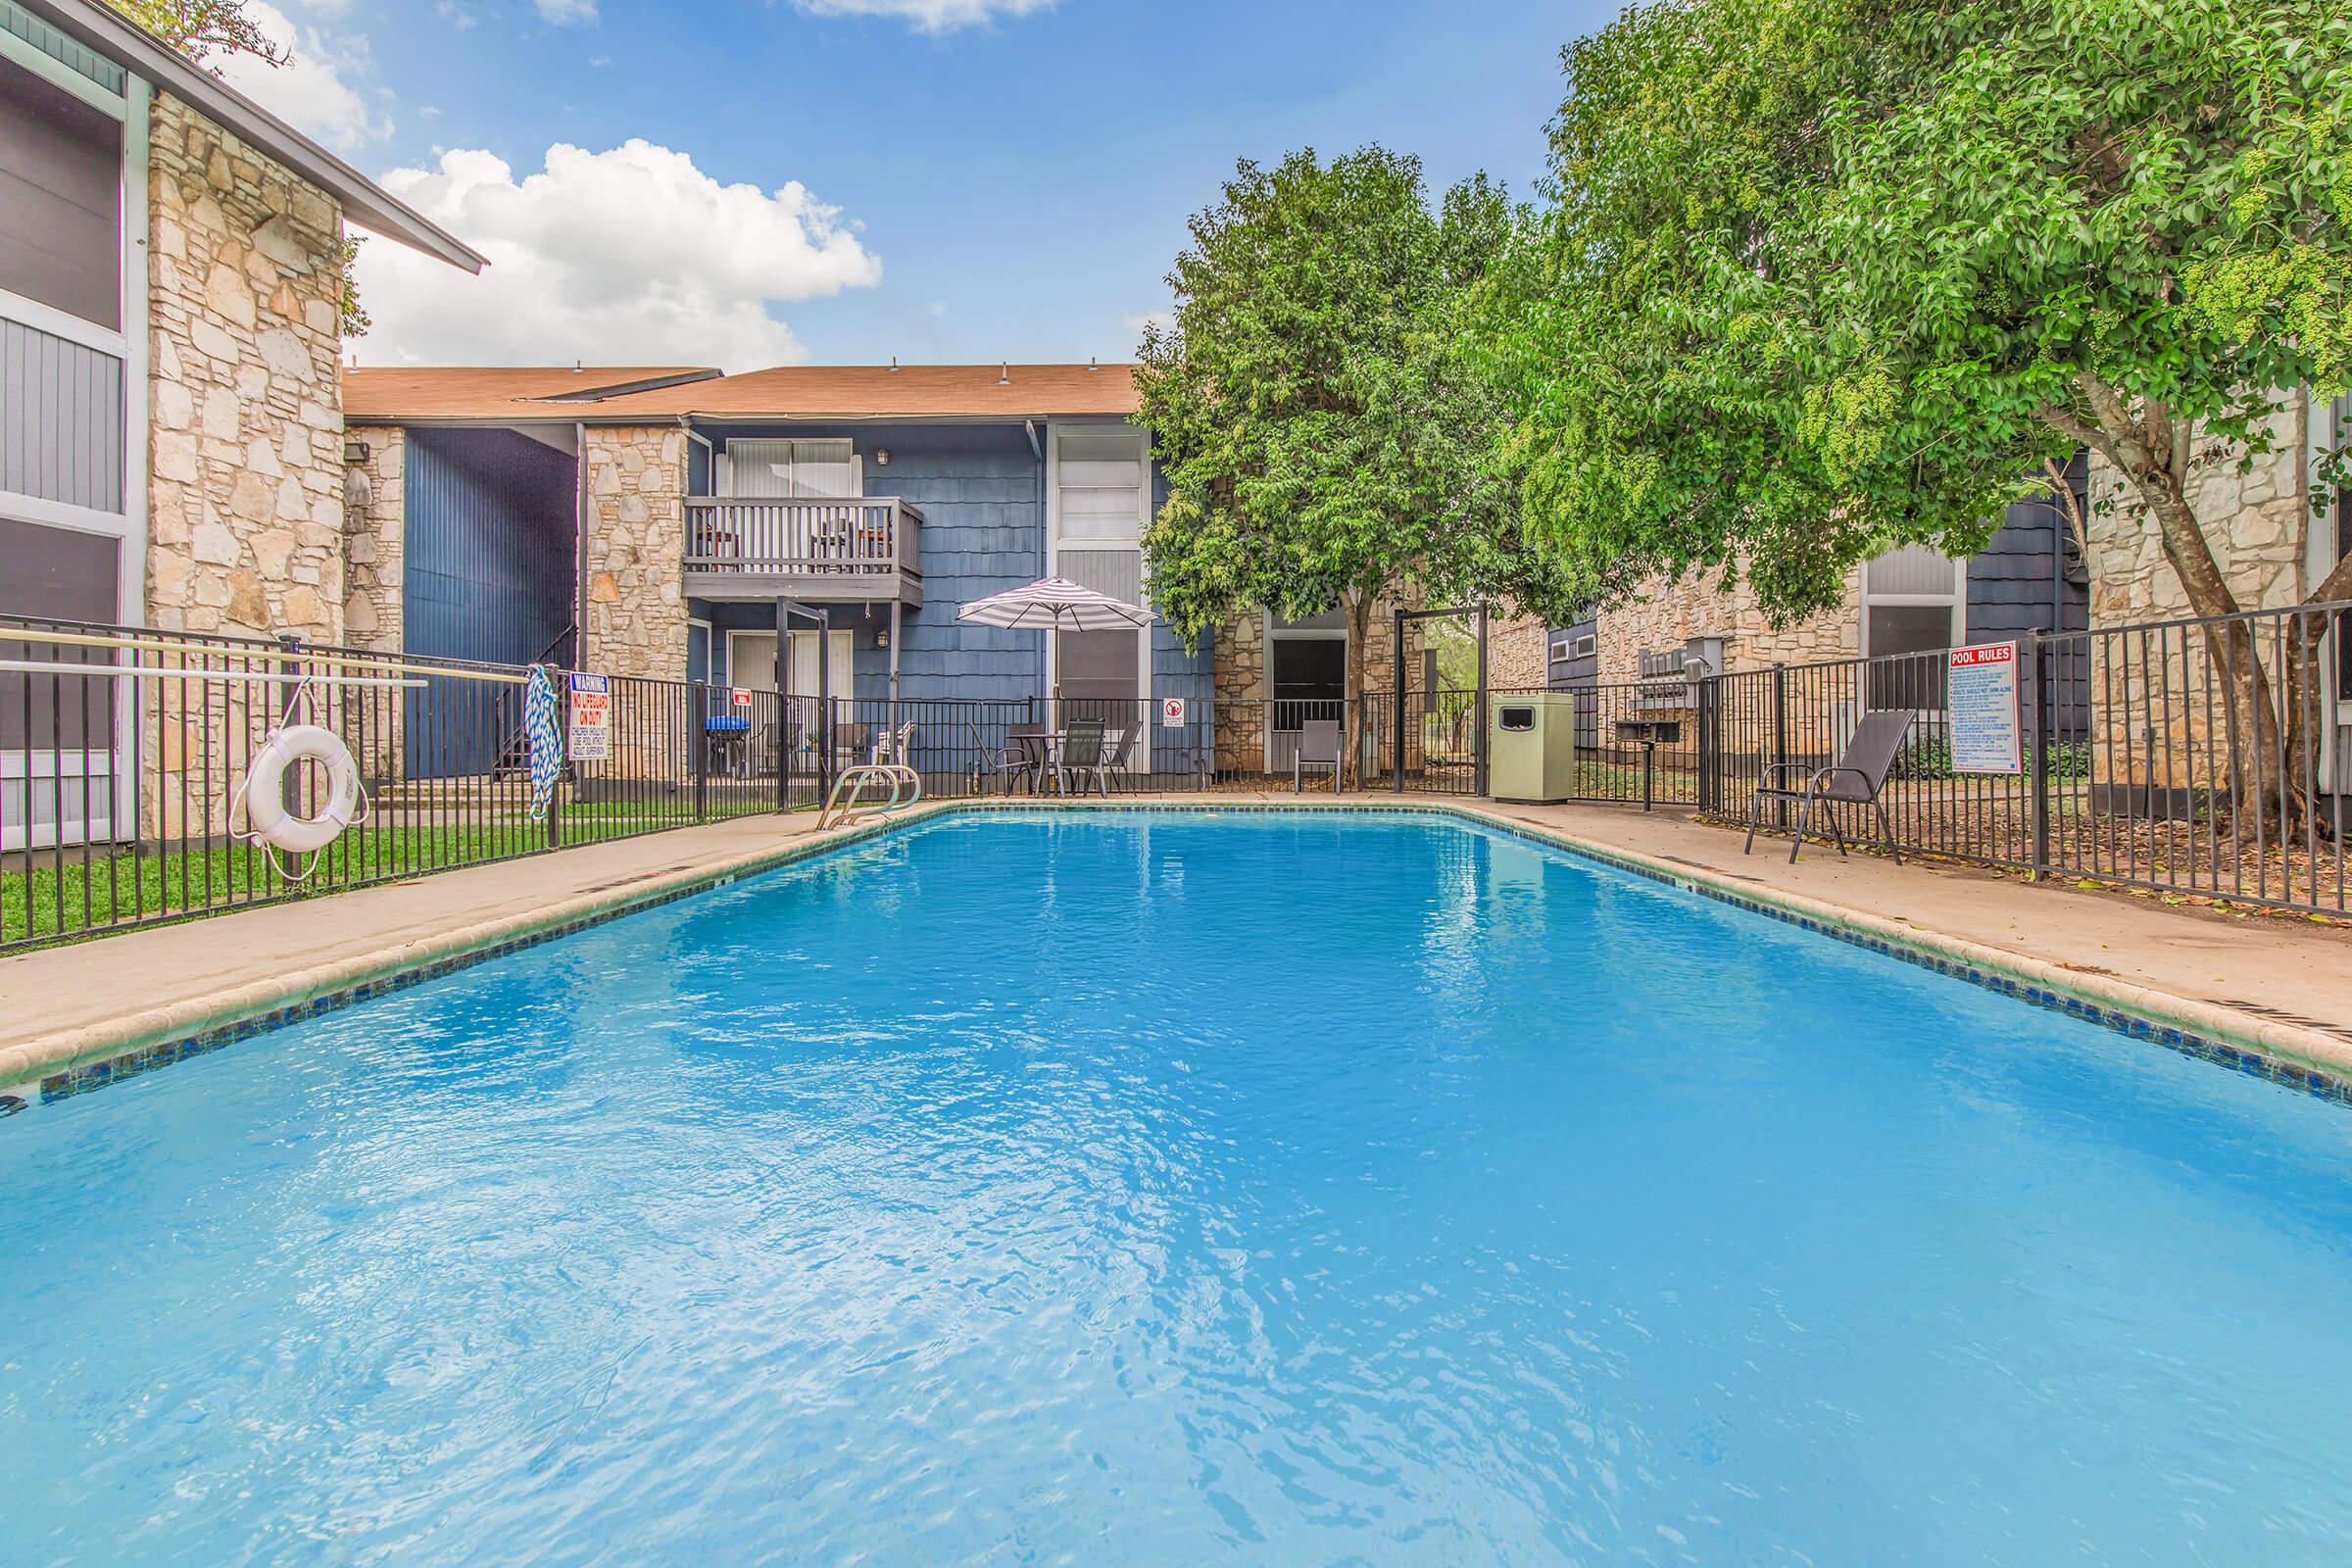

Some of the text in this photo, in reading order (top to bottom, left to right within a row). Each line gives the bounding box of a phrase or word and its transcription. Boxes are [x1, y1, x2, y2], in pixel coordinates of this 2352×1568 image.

[1952, 648, 2009, 664] POOL RULES
[575, 675, 605, 692] WARNING
[573, 693, 608, 710] NO LIFEGUARD
[580, 710, 602, 726] ON DUTY
